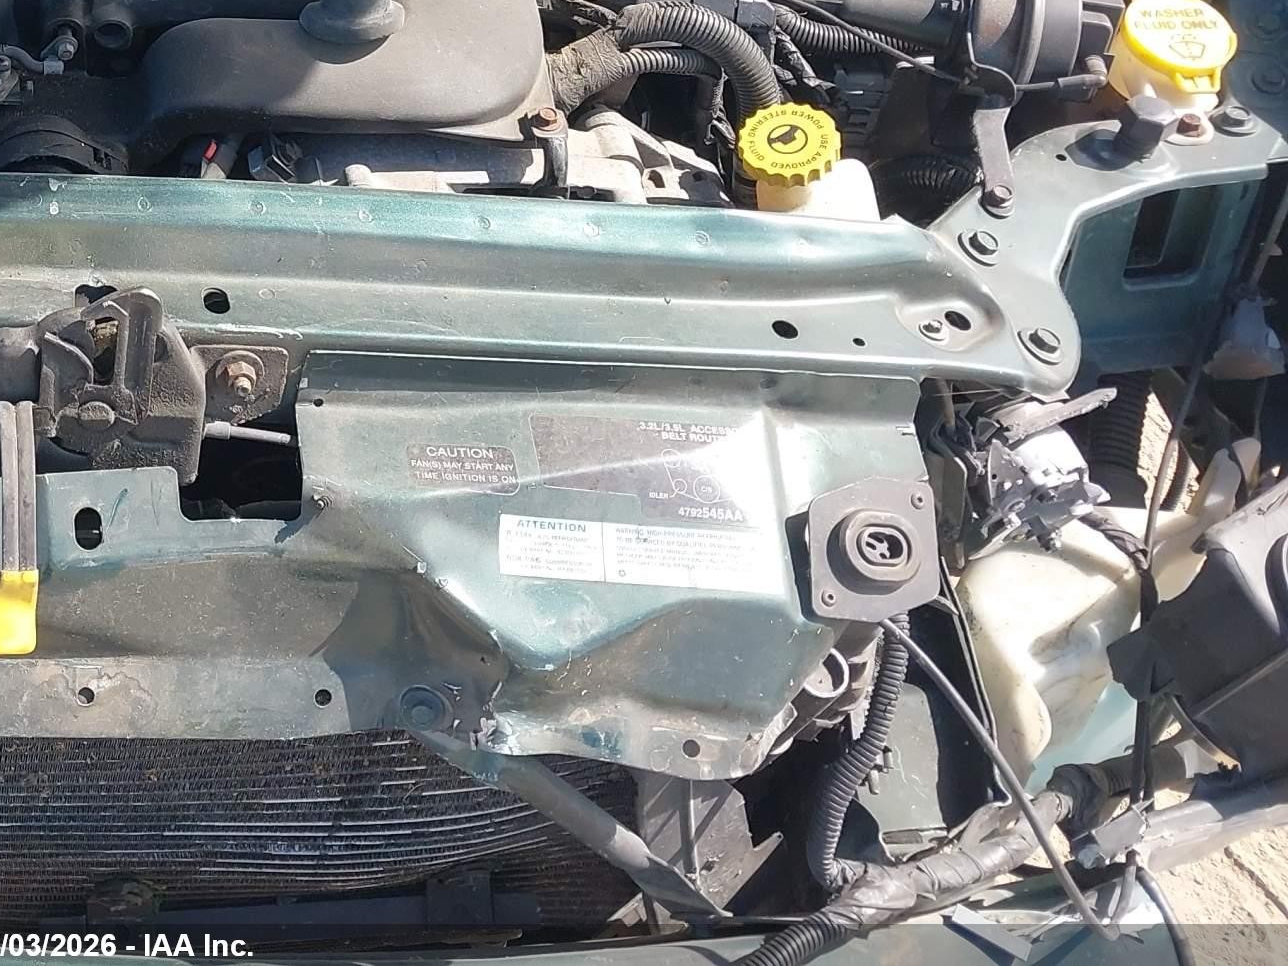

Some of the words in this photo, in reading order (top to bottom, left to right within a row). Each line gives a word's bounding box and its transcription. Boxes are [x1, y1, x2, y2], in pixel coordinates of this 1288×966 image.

[1139, 8, 1204, 18] WASHER
[1134, 20, 1176, 30] FLUID
[1181, 20, 1218, 30] ONLY
[747, 109, 787, 139] STEERING
[791, 109, 824, 131] POWER
[819, 133, 829, 150] USE
[746, 140, 765, 161] FLUID
[770, 151, 822, 170] APPROVED
[690, 424, 741, 435] ACCESSO
[661, 433, 688, 441] BELT
[426, 446, 494, 459] CAUTION
[410, 459, 441, 470] FAN(S)
[443, 461, 463, 470] MAY
[463, 462, 493, 471] START
[494, 463, 514, 472] ANY
[415, 471, 439, 480] TIME
[441, 472, 486, 483] IGNITION
[487, 474, 498, 484] IS
[500, 475, 516, 484] ON
[648, 491, 669, 499] IDLER
[678, 506, 744, 521] 4792545AA
[516, 519, 587, 533] ATTENTION
